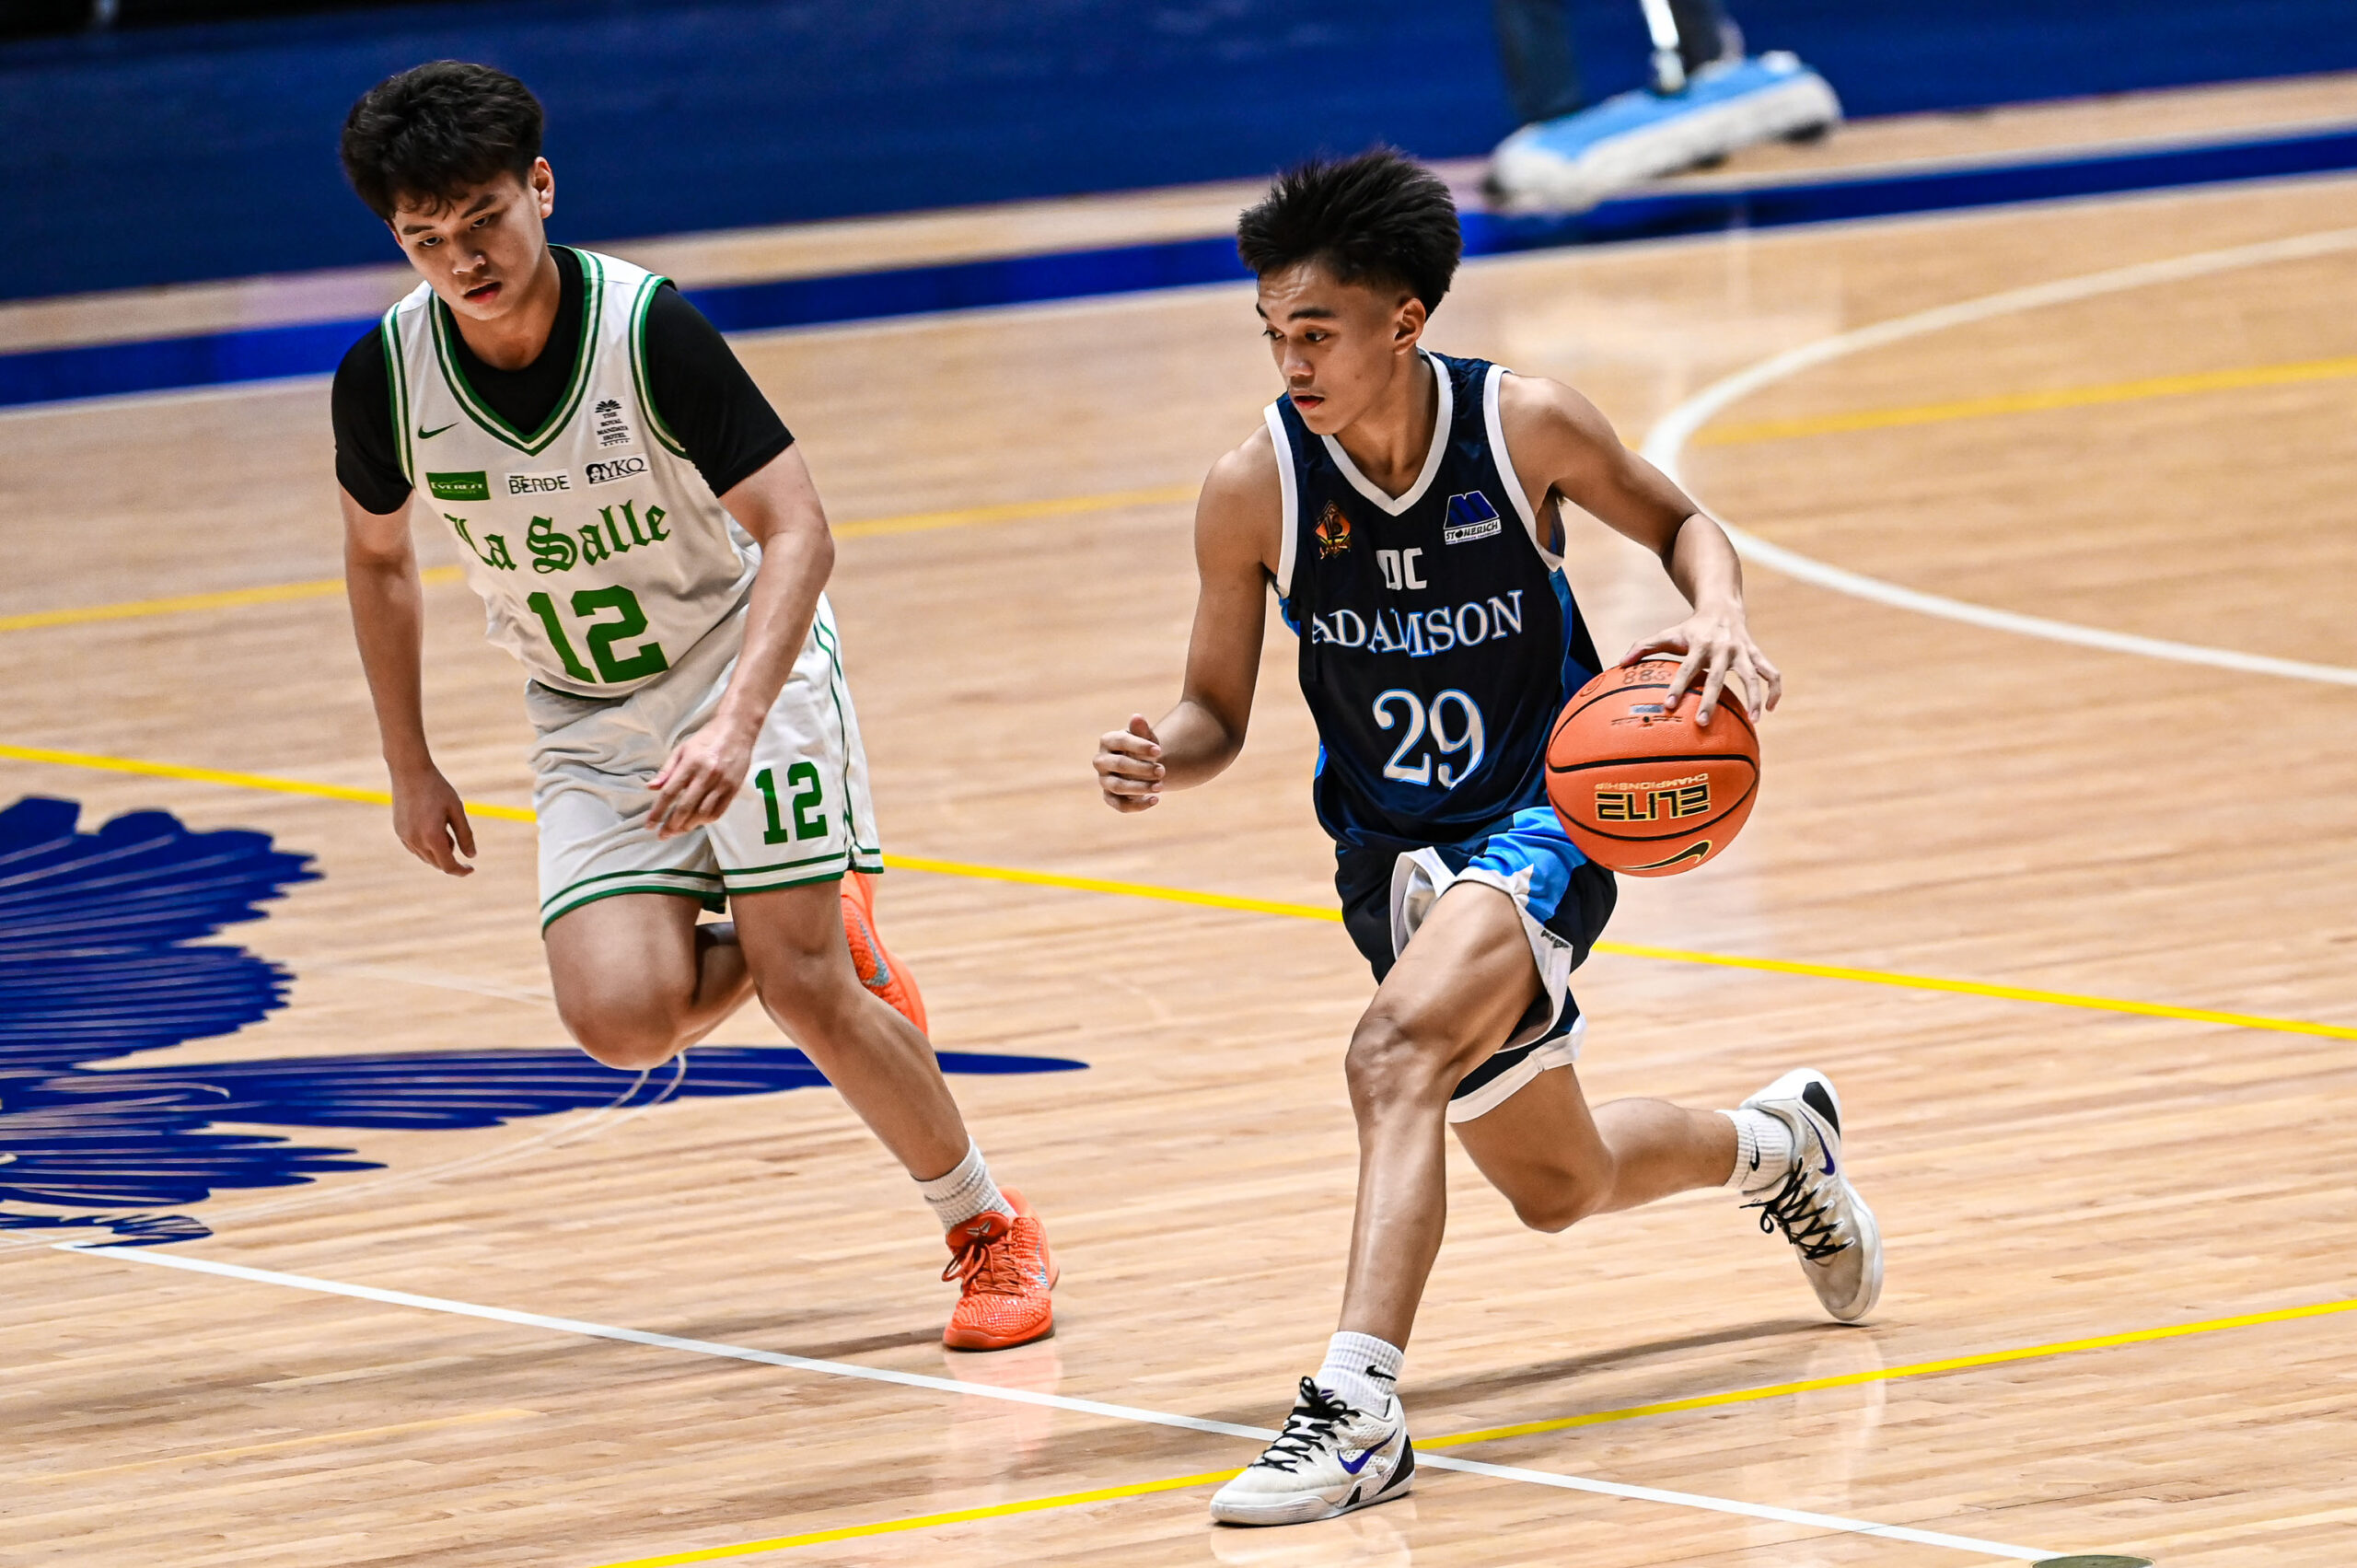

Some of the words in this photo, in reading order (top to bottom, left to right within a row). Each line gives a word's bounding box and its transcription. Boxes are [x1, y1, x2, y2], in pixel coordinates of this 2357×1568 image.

[508, 474, 571, 494] BERDE
[526, 498, 671, 575] Salle
[527, 585, 669, 684] 12
[1312, 589, 1523, 658] ADAMSON
[1372, 688, 1485, 791] 29
[755, 761, 828, 845] 12
[1594, 783, 1712, 822] ELITE
[1595, 772, 1709, 790] CHAMPIONSHIP
